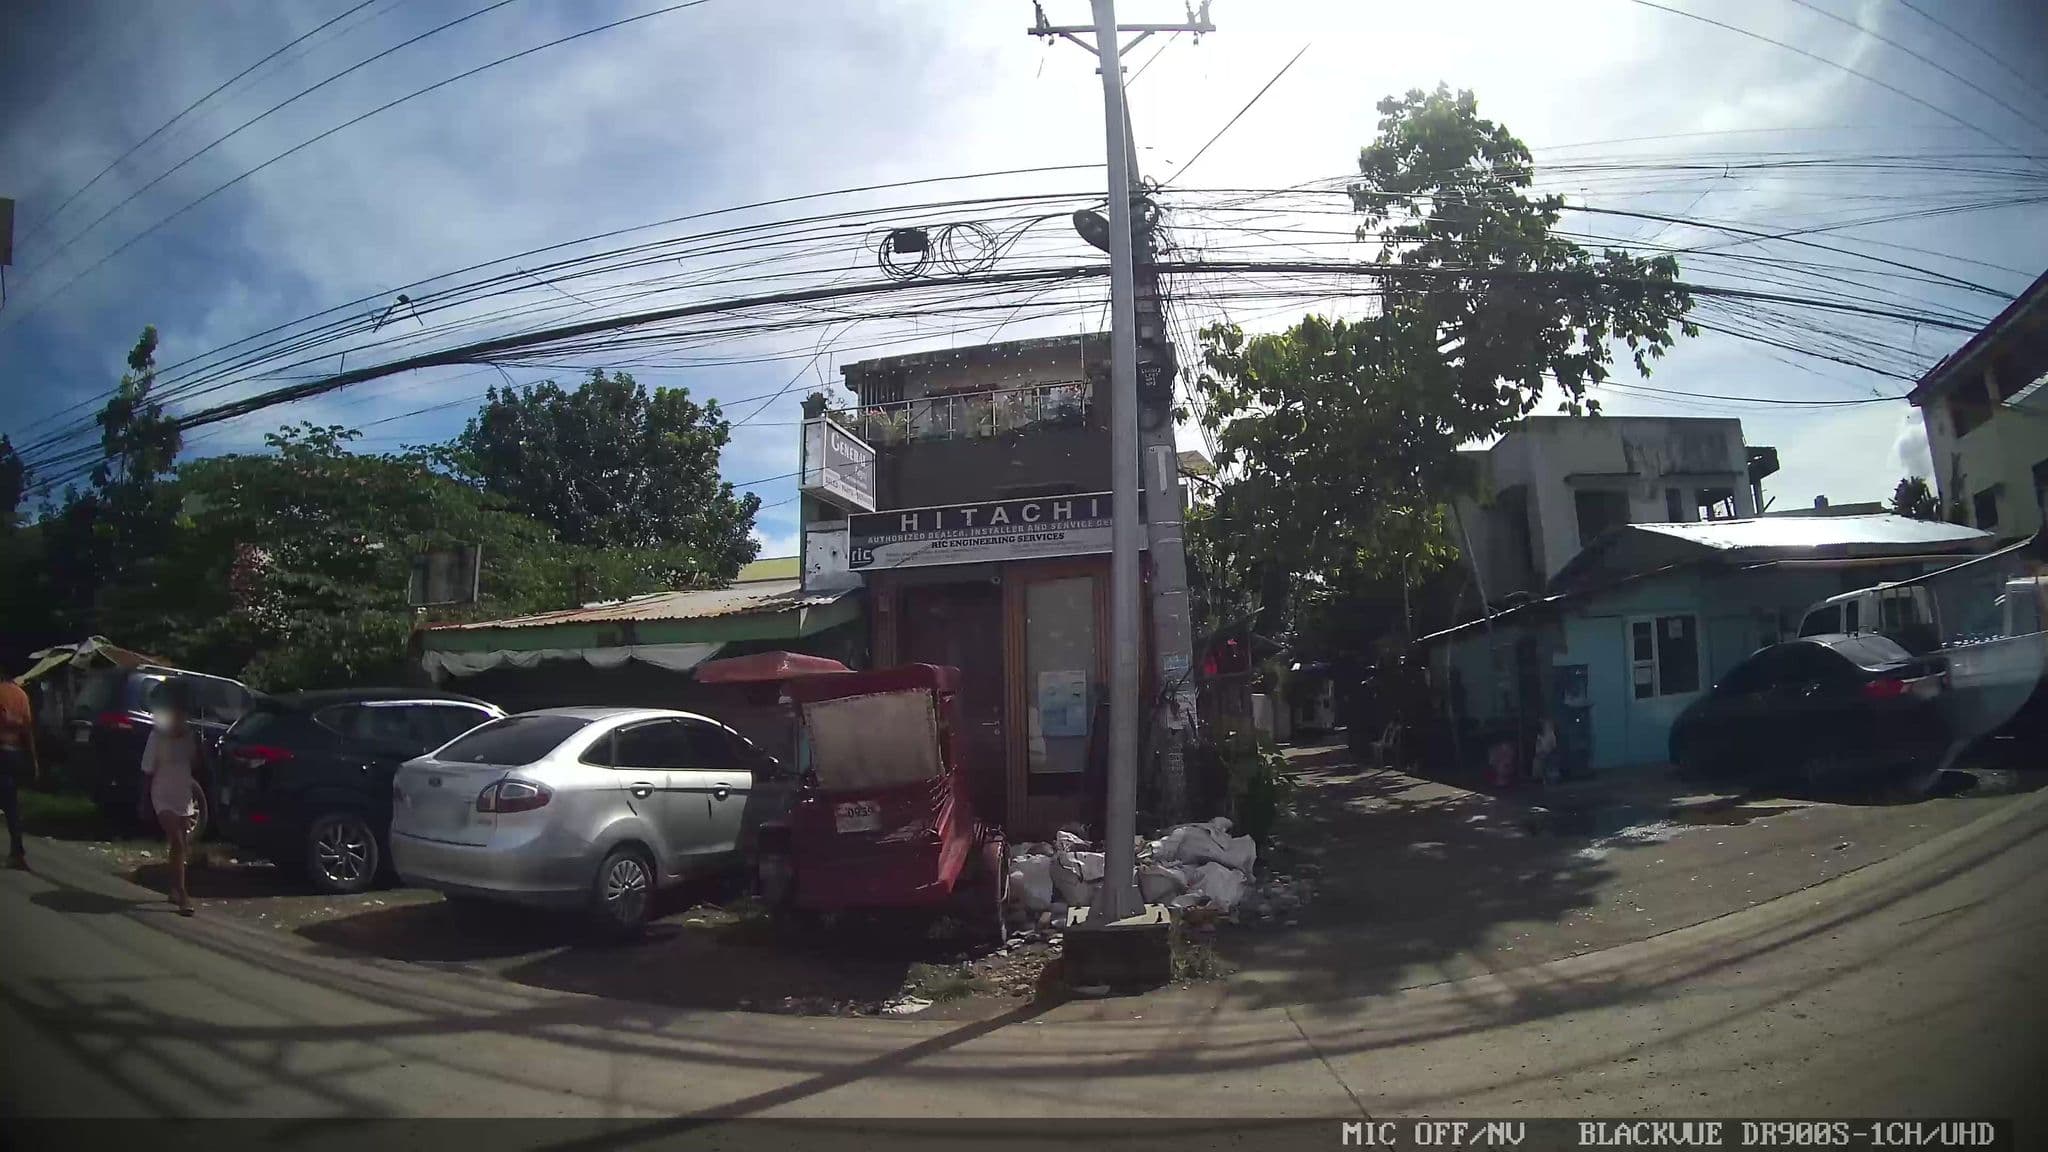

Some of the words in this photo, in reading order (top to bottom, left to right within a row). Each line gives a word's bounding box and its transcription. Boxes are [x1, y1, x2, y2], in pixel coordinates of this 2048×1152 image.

[901, 499, 1097, 531] HITACHI
[868, 532, 925, 543] AUTHORIZED
[971, 524, 1024, 536] INSTALLER
[1028, 523, 1047, 532] AND
[1051, 520, 1093, 530] SERVICE
[931, 540, 948, 549] RIC
[950, 535, 1015, 548] ENGINEERING
[1017, 532, 1065, 543] SERVICES
